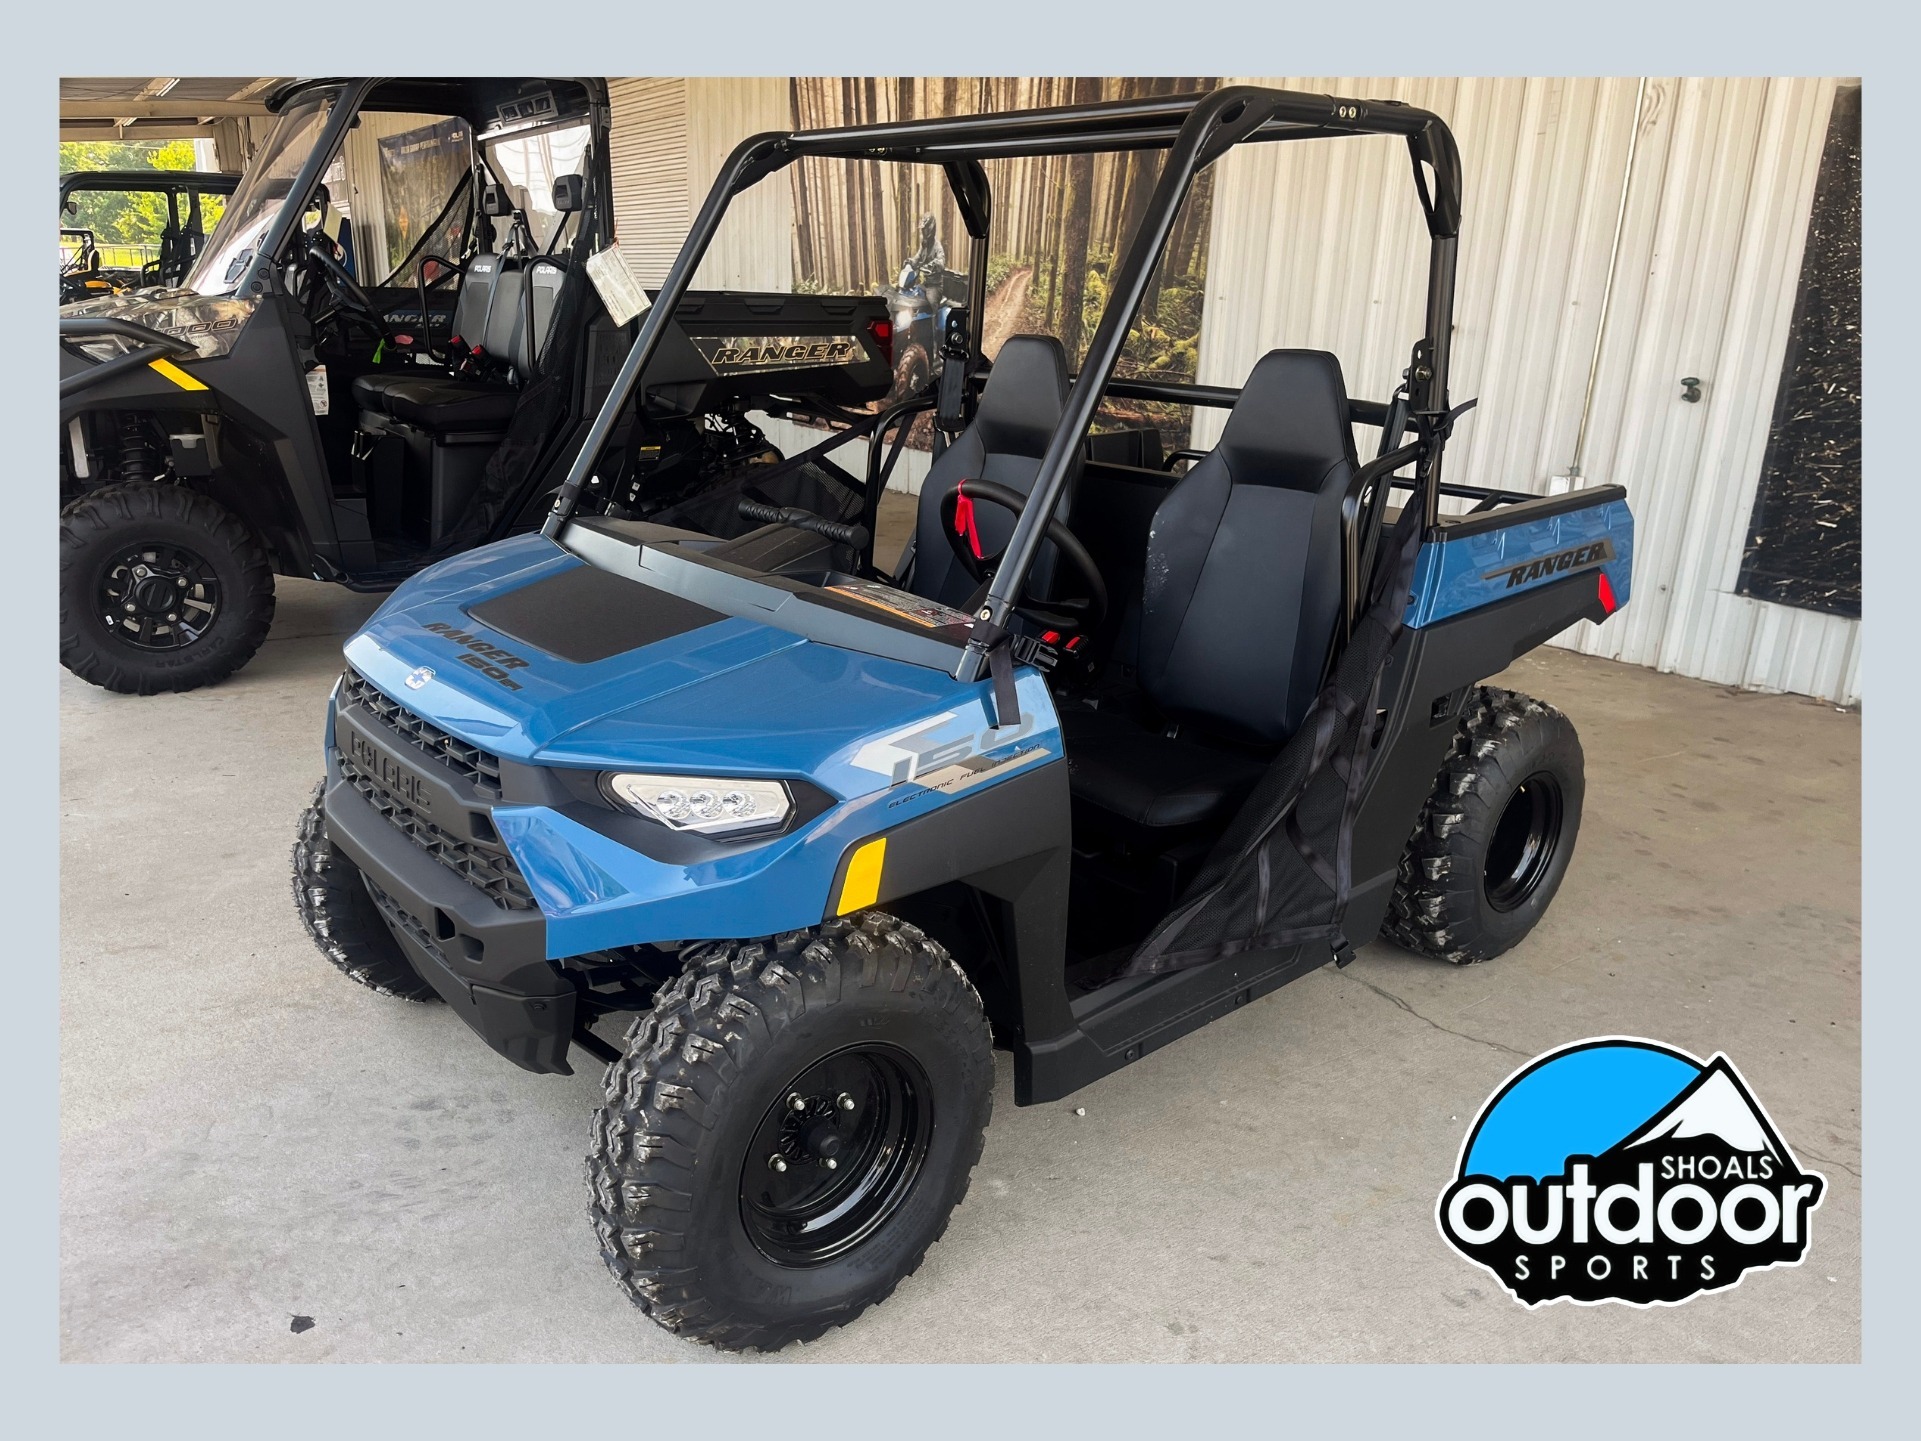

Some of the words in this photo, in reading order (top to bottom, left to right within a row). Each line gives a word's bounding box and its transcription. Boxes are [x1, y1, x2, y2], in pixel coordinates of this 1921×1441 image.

[473, 264, 492, 273] POLARIS
[535, 265, 558, 275] POLARIS
[162, 317, 239, 336] 000
[711, 342, 850, 365] RANGER
[1505, 541, 1608, 589] RANGER
[422, 622, 530, 669] RANGER
[350, 730, 432, 815] POLARIS
[888, 778, 955, 809] ELECTRONIC
[959, 766, 986, 781] FUEL
